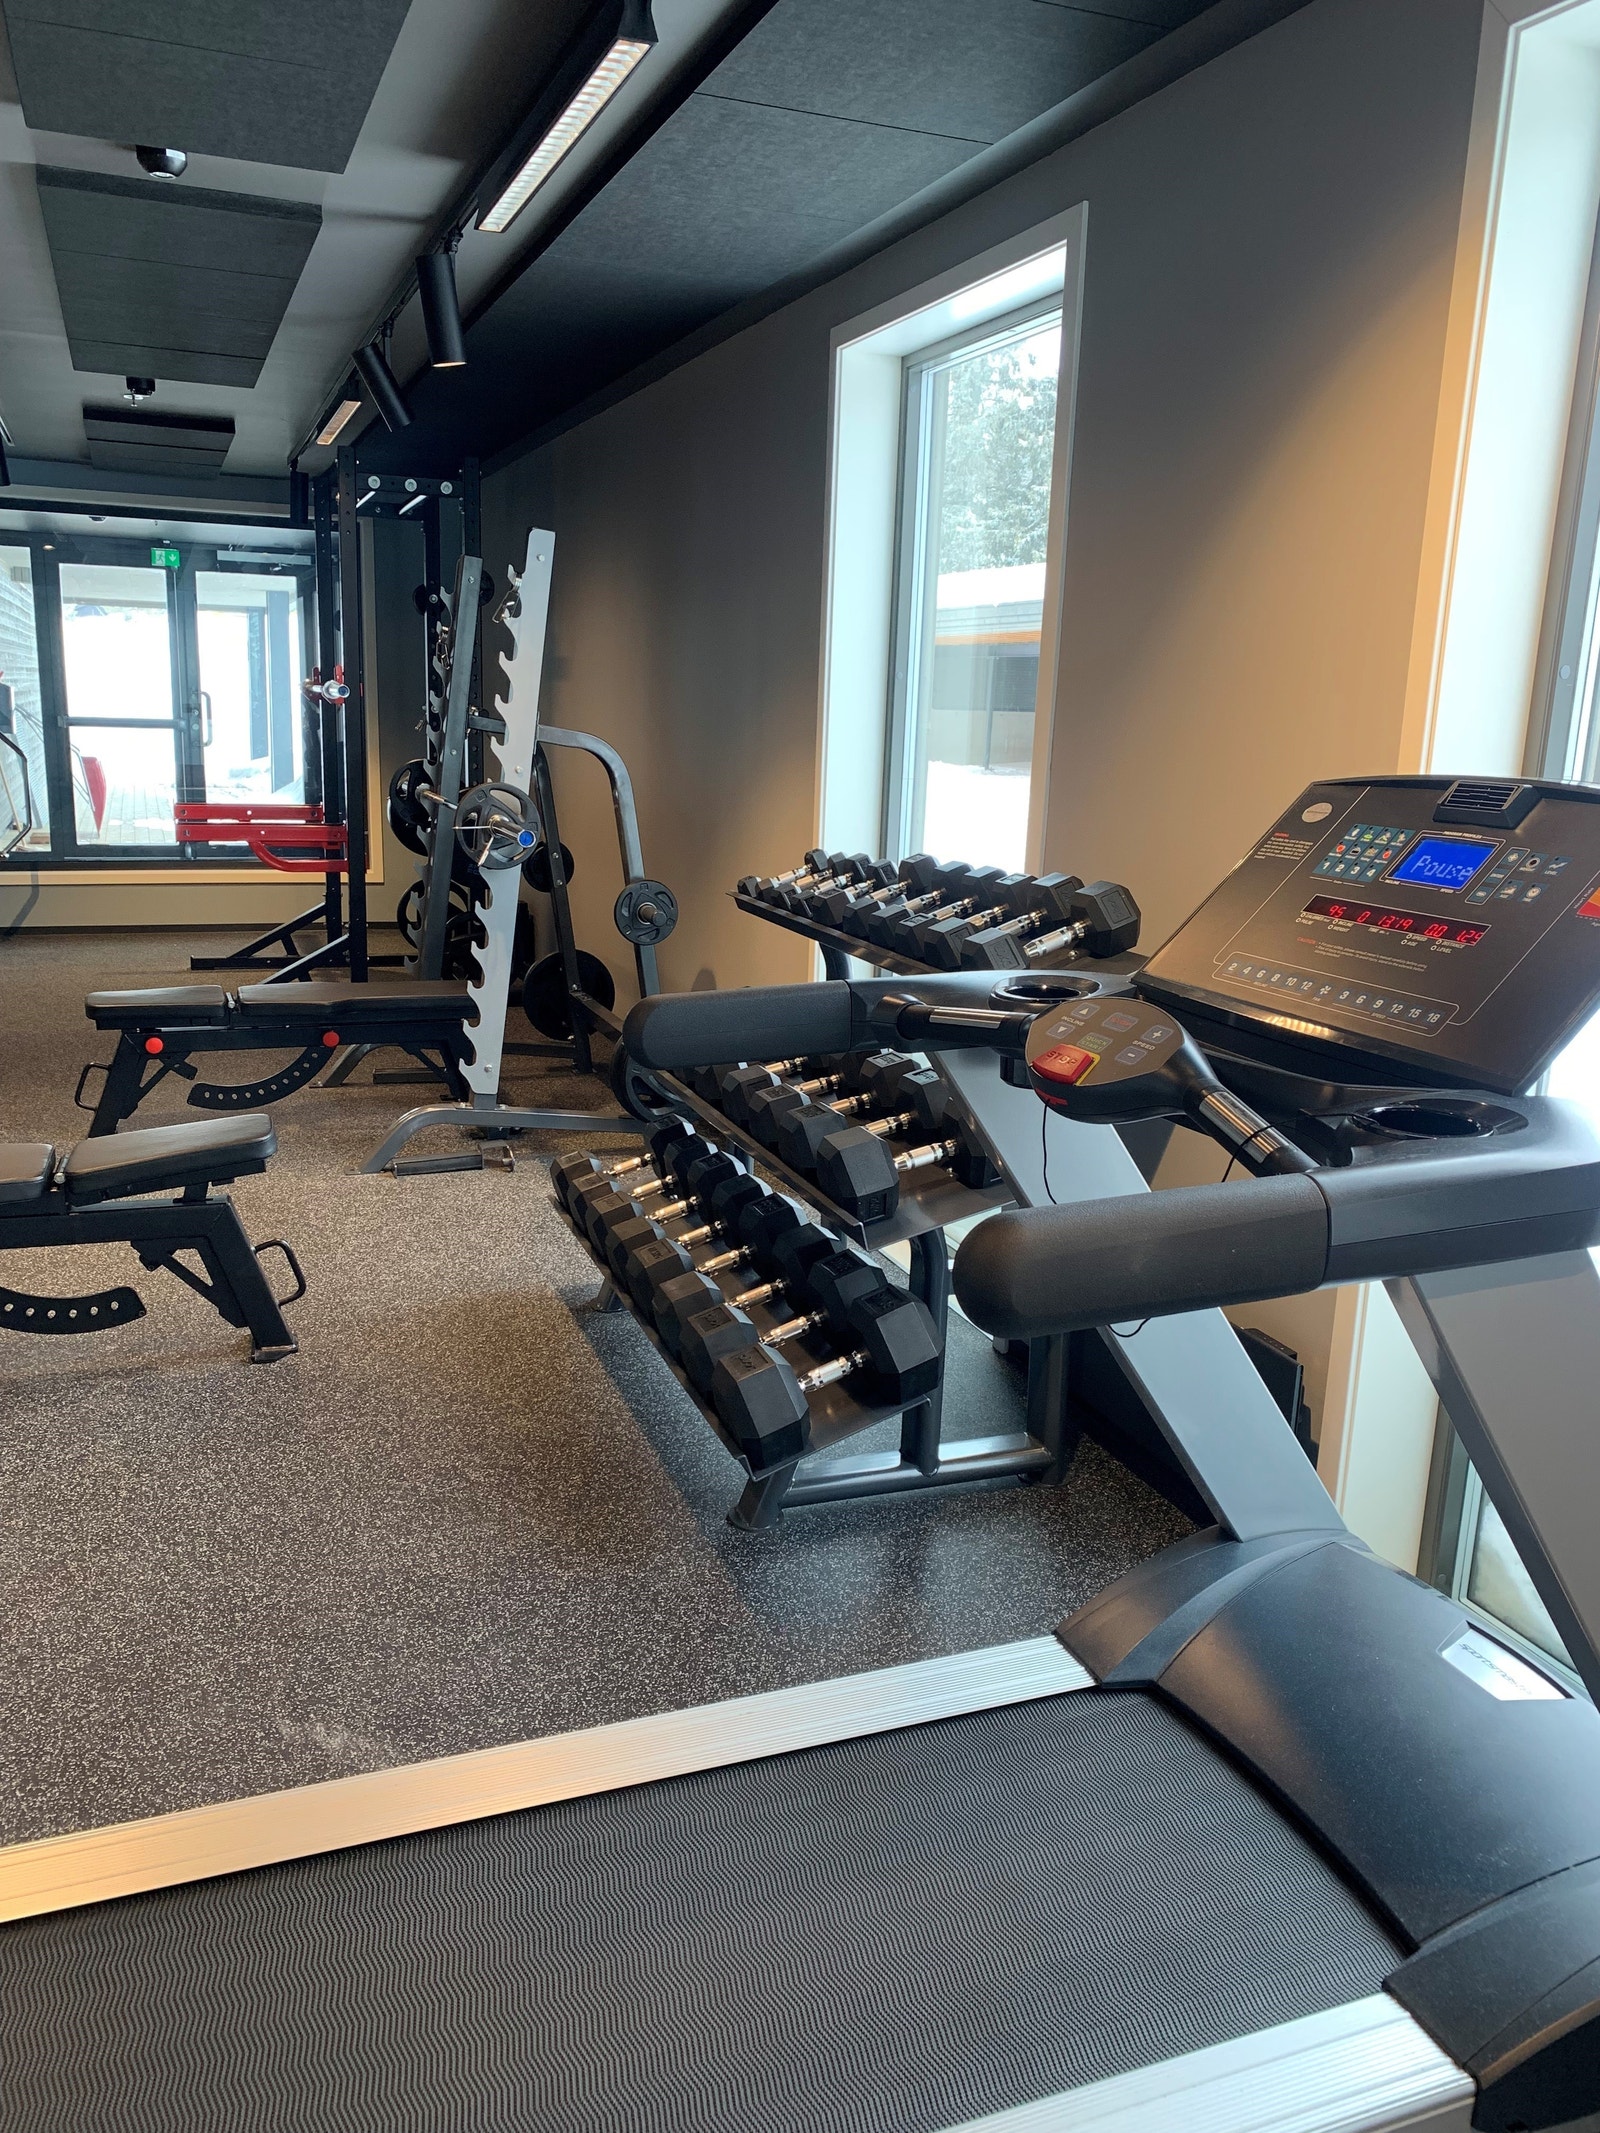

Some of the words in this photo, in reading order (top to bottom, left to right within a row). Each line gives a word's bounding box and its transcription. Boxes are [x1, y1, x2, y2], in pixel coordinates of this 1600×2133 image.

[1322, 861, 1331, 870] 1
[1335, 863, 1345, 873] 2
[1350, 866, 1360, 875] 3
[1366, 868, 1376, 877] 4
[1329, 905, 1347, 918] 95
[1357, 911, 1371, 923] 0
[1228, 962, 1238, 971] 2
[1242, 966, 1252, 975] 4
[1256, 970, 1266, 978] 6
[1270, 973, 1281, 982] 8
[1285, 976, 1298, 986] 10
[1300, 981, 1313, 991] 12
[1339, 990, 1350, 1000] 3
[1356, 995, 1367, 1004] 6
[1372, 999, 1384, 1009] 9
[1390, 1003, 1404, 1014] 12
[1408, 1008, 1422, 1018] 15
[1426, 1012, 1441, 1023] 18
[1061, 1015, 1086, 1027] INCLINE
[1081, 1040, 1102, 1051] START
[1086, 1035, 1107, 1046] QUICK
[1132, 1039, 1156, 1051] SPEED
[1046, 1050, 1077, 1064] STOP
